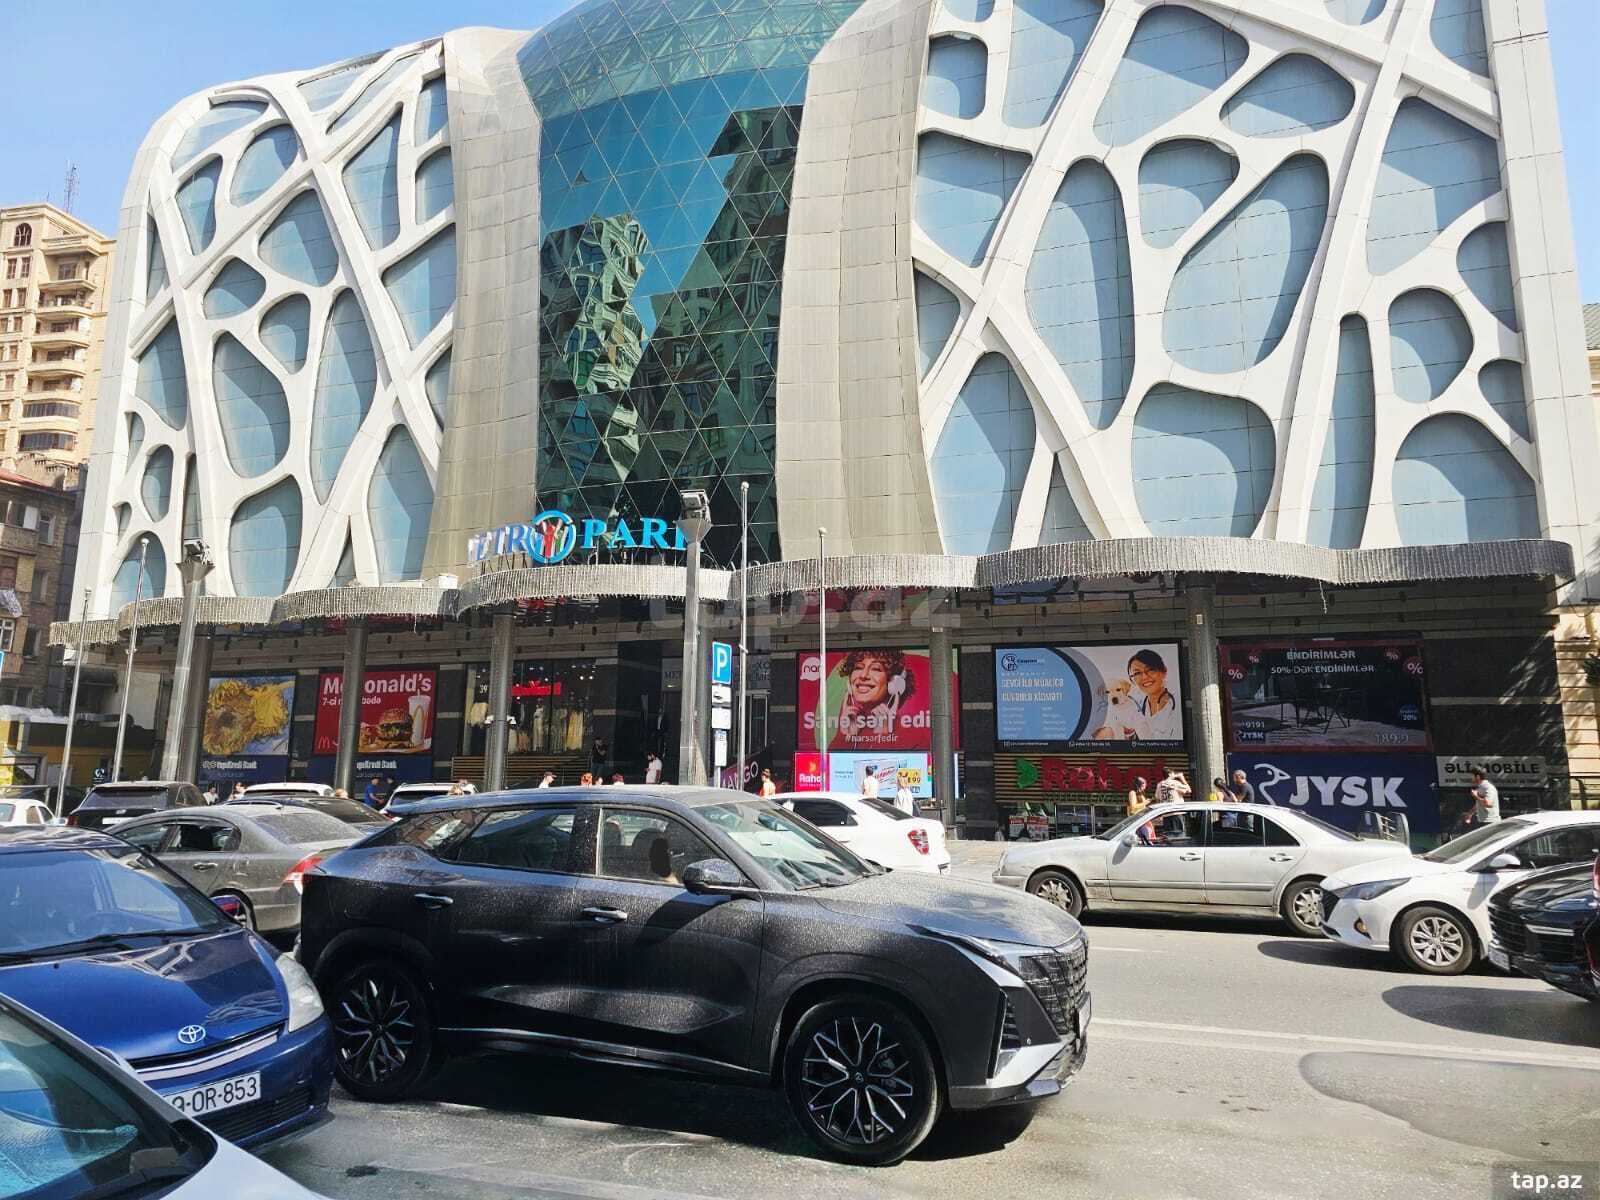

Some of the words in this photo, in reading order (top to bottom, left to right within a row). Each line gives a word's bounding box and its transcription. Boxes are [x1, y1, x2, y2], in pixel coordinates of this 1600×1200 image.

[717, 648, 728, 678] P
[323, 673, 432, 694] Monald's
[901, 710, 931, 728] edi
[799, 773, 823, 783] Raha
[1444, 761, 1471, 774] ƏLİ
[1289, 775, 1408, 808] JYSK
[172, 1076, 257, 1113] 9-OR-853
